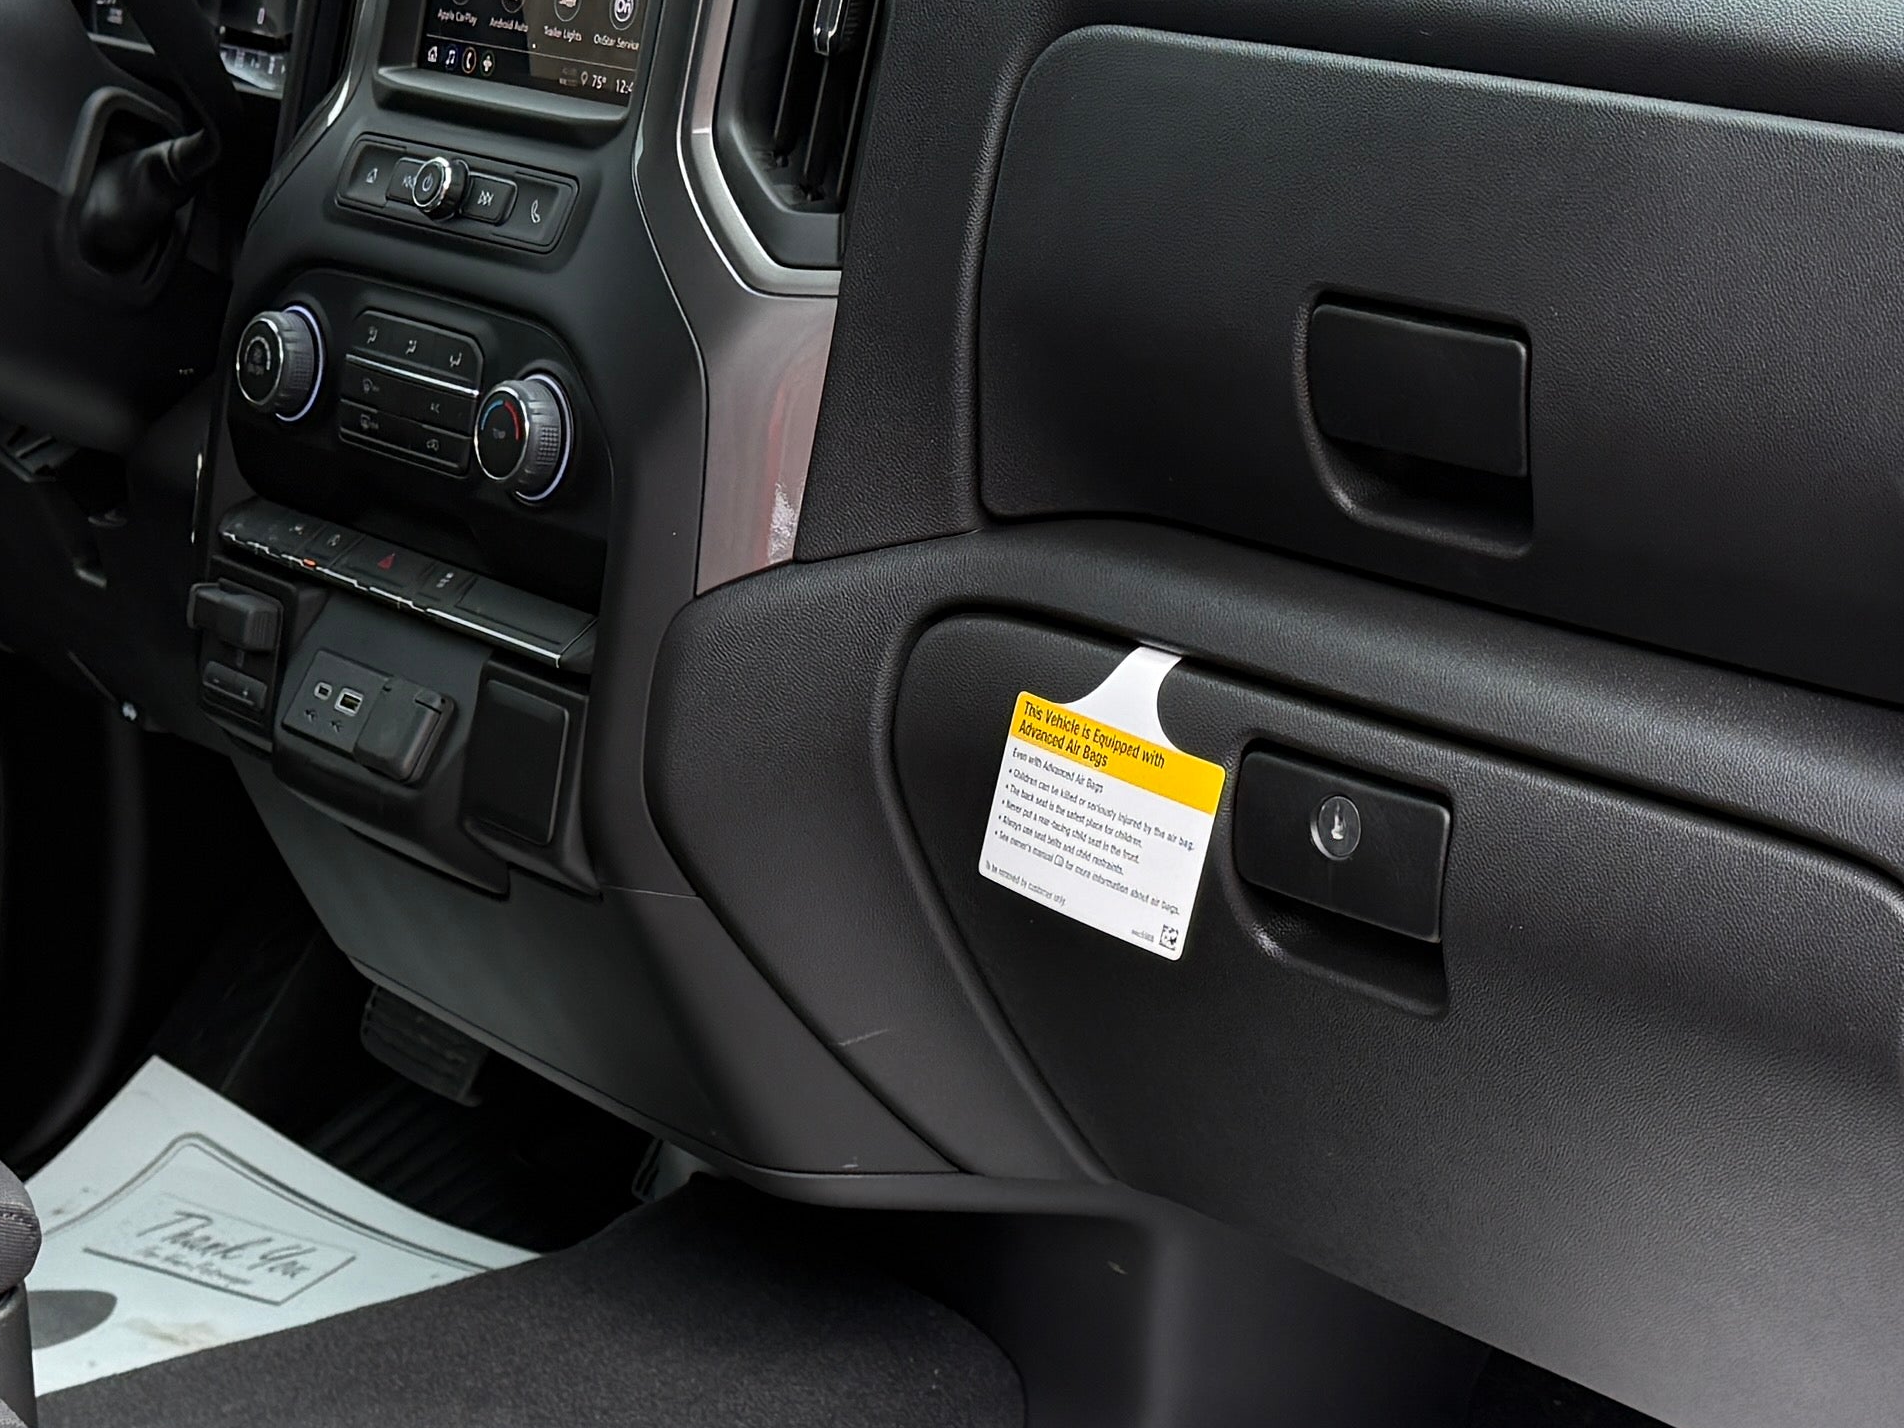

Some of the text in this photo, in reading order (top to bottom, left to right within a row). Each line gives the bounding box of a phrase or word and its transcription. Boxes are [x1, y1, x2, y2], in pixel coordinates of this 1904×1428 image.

[563, 29, 583, 43] Lights
[1018, 719, 1109, 768] Advanced Air Bags
[1024, 700, 1165, 769] This Vehicle is Equipped with
